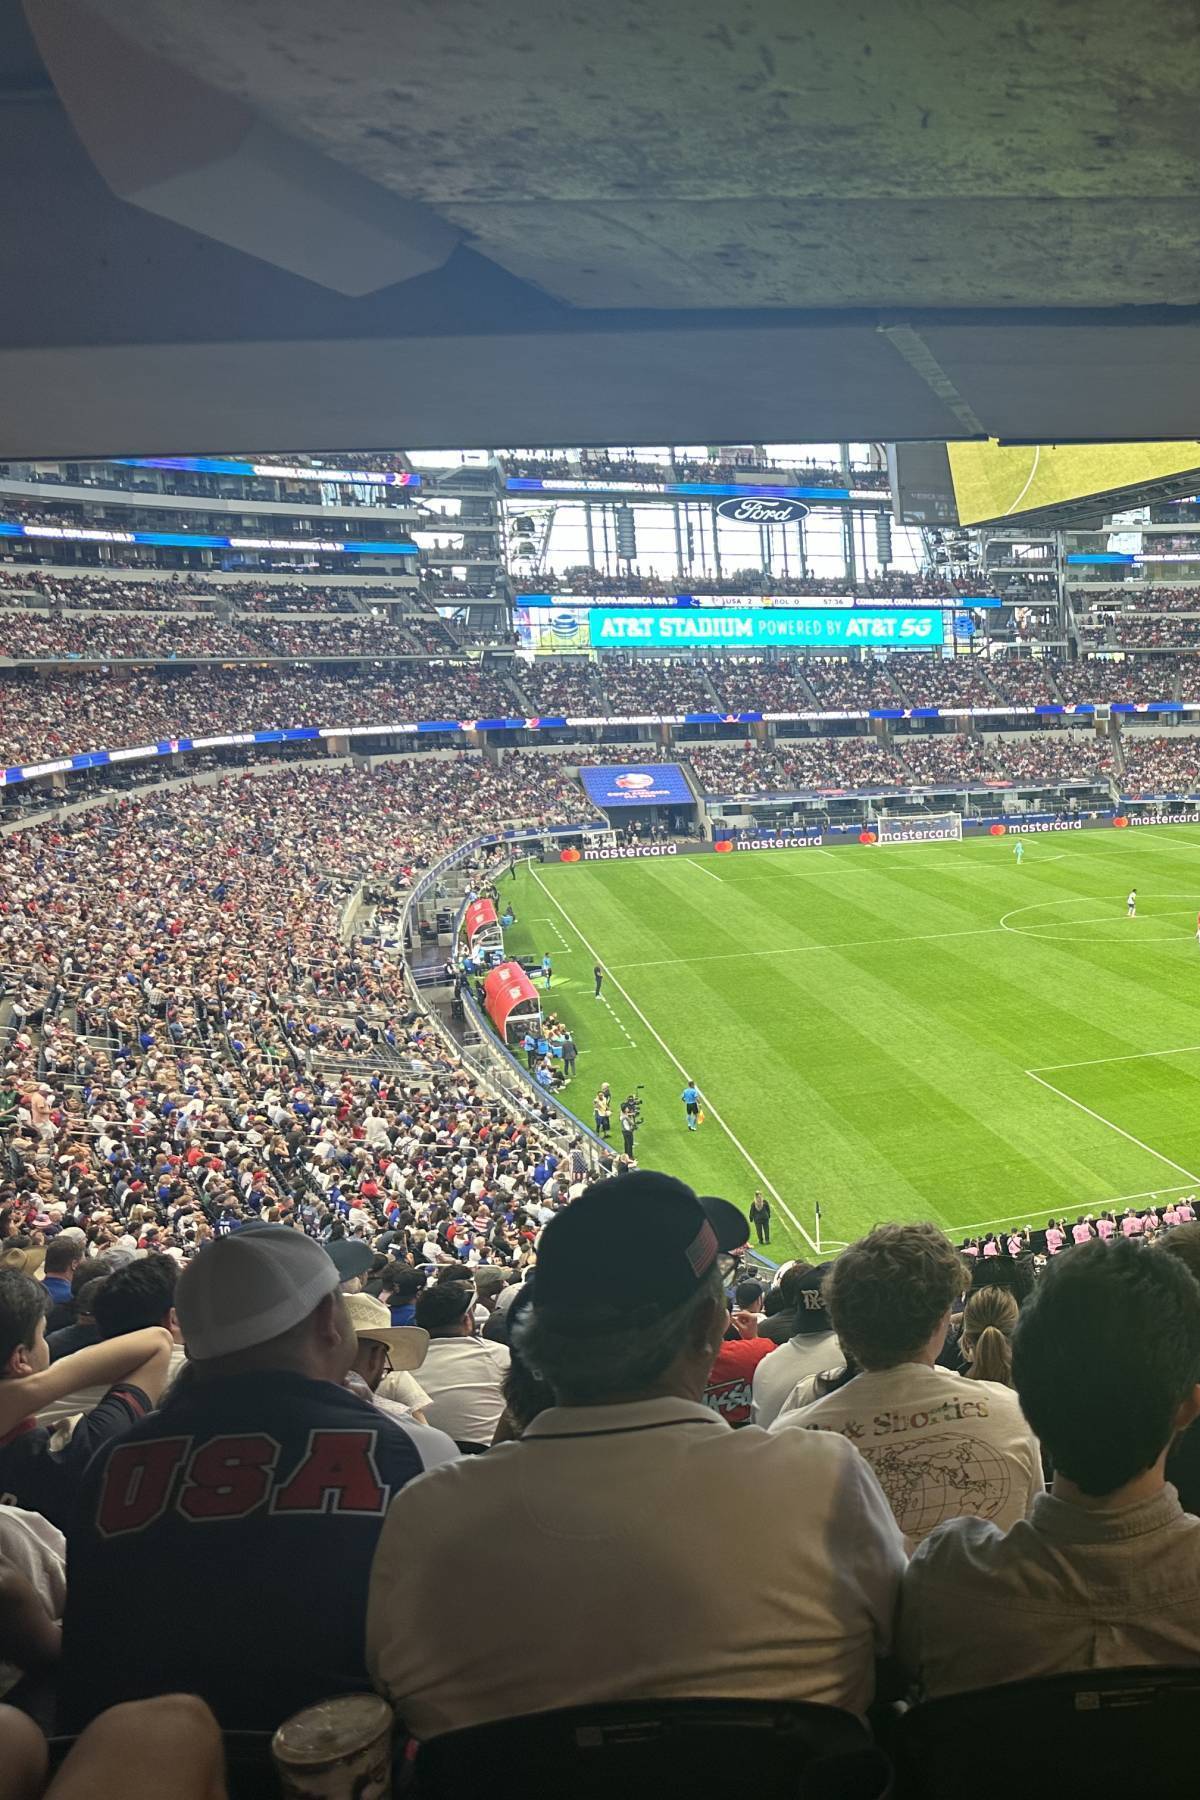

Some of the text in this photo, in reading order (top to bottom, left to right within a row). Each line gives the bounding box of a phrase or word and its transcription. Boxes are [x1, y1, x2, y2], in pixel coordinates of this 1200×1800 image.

[734, 499, 793, 521] Ford
[600, 617, 933, 638] AT&T STADIUM POWERED BY AT&T 5G
[1008, 818, 1082, 834] mastercard
[1130, 812, 1200, 827] mastercard
[737, 835, 822, 850] mastercard
[879, 826, 958, 842] mastercard
[584, 843, 677, 861] mastercard
[97, 1429, 390, 1538] USA
